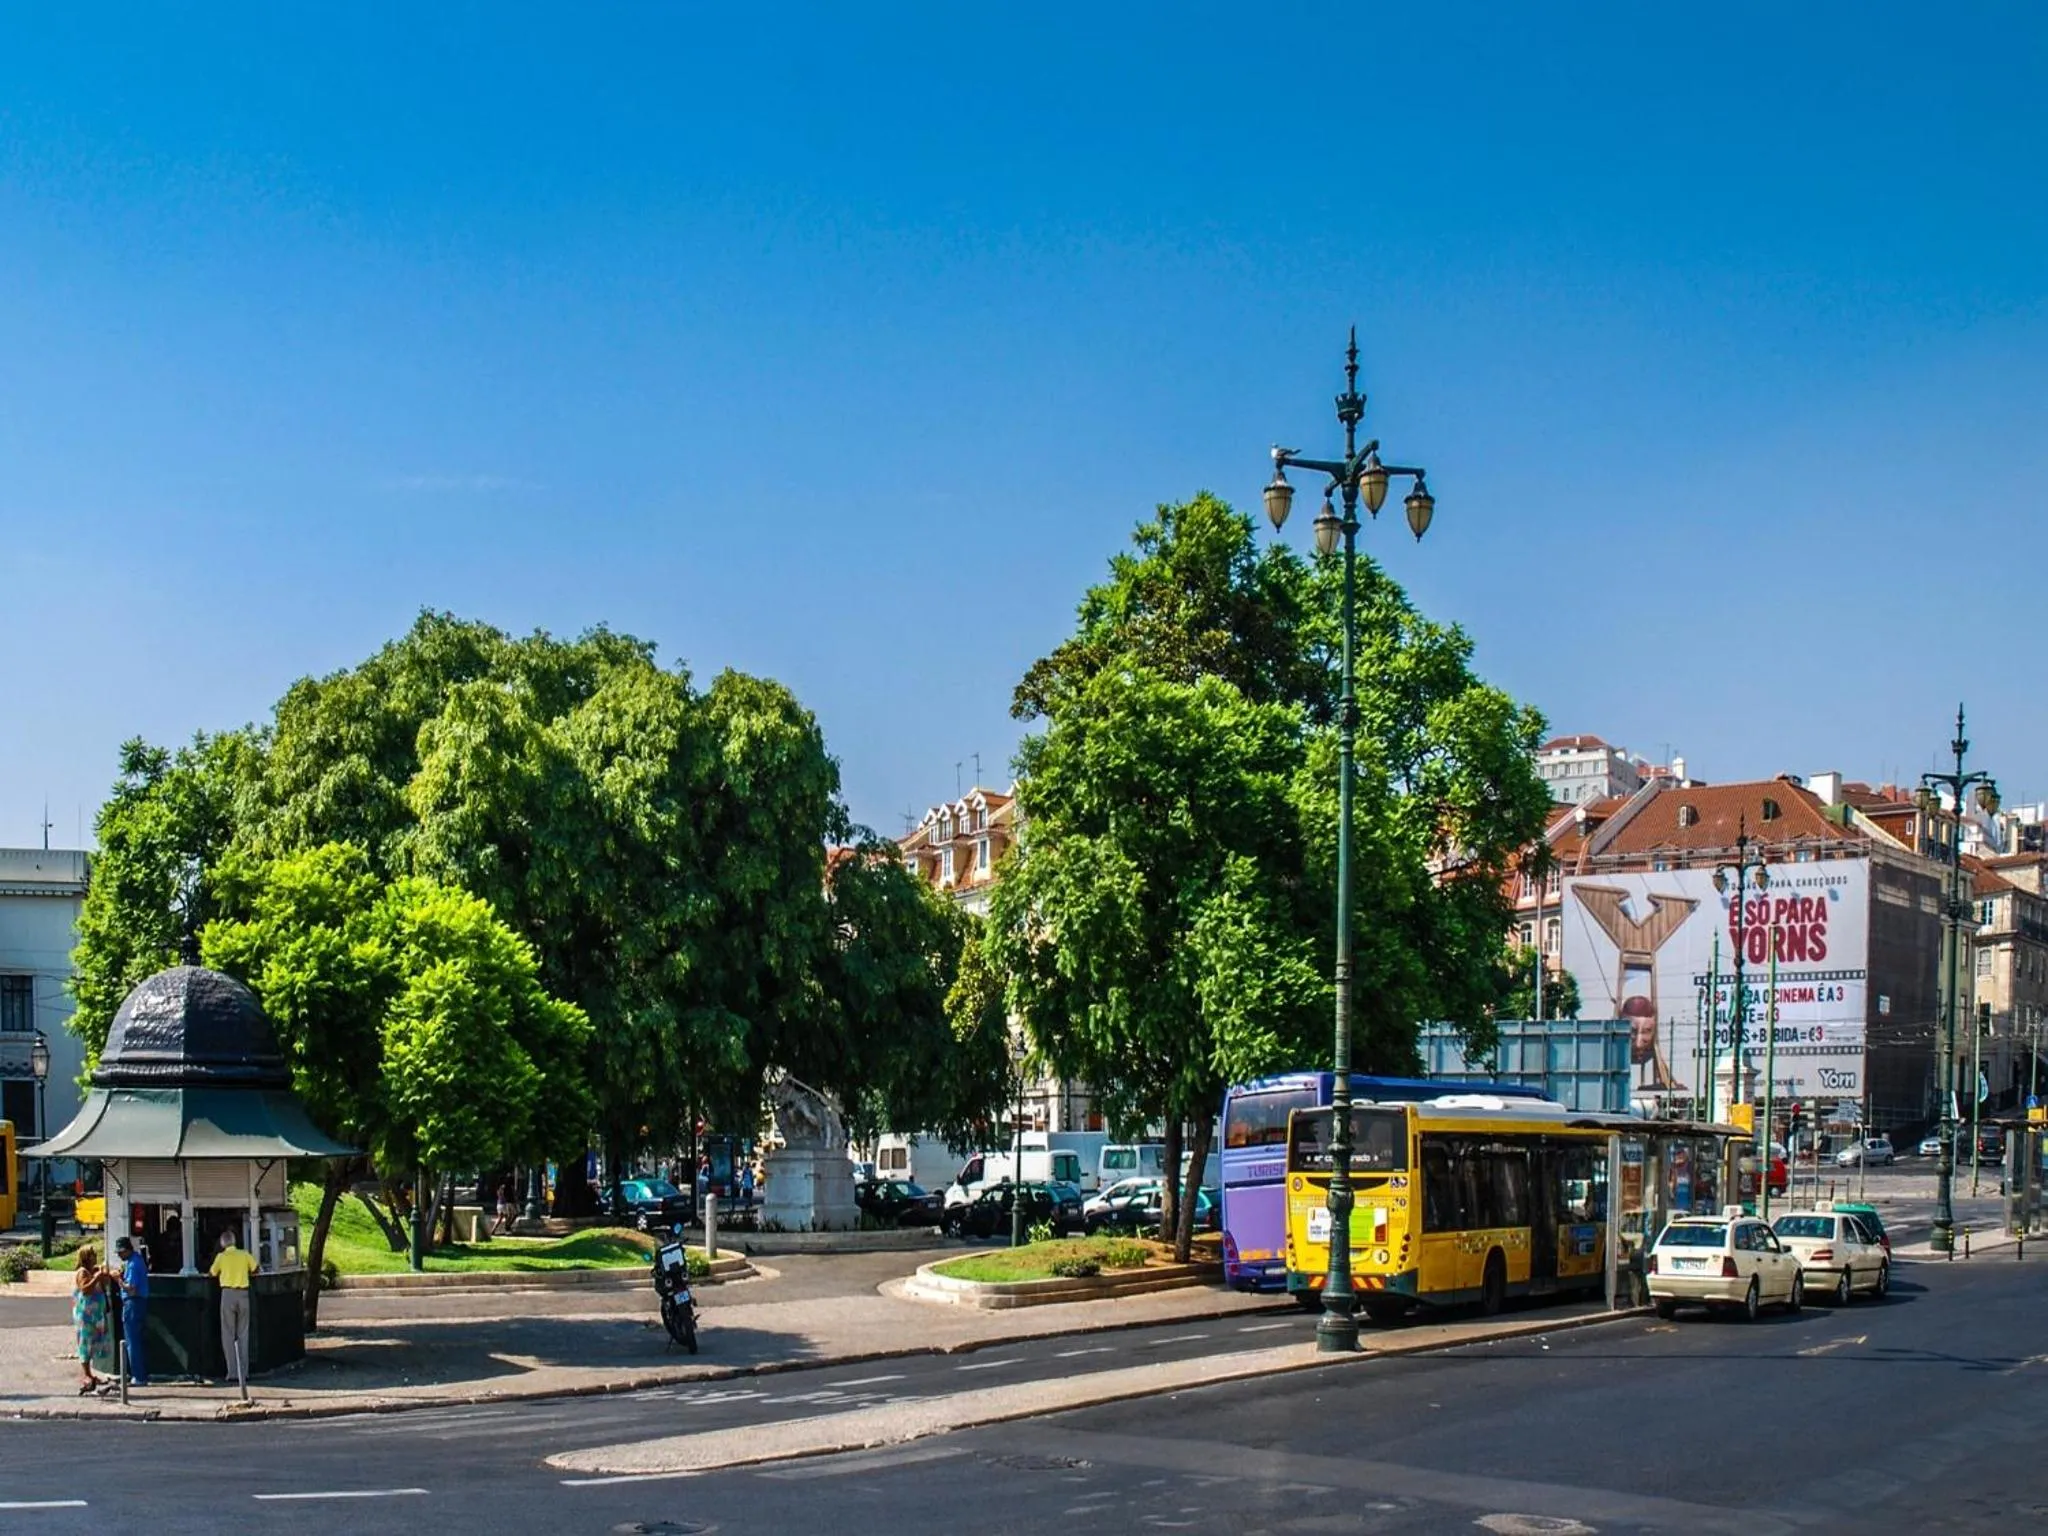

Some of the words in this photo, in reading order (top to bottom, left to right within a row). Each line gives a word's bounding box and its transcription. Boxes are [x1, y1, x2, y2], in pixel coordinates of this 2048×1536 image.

[1744, 893, 1770, 926] SÓ
[1775, 896, 1828, 925] PARA
[1729, 922, 1827, 964] YORNS
[1772, 986, 1815, 1003] CINEMA
[1817, 982, 1825, 1001] É
[1827, 987, 1834, 1001] A
[1837, 986, 1844, 1001] 3
[1760, 1027, 1799, 1044] BBIDA
[1818, 1068, 1856, 1089] Yorn
